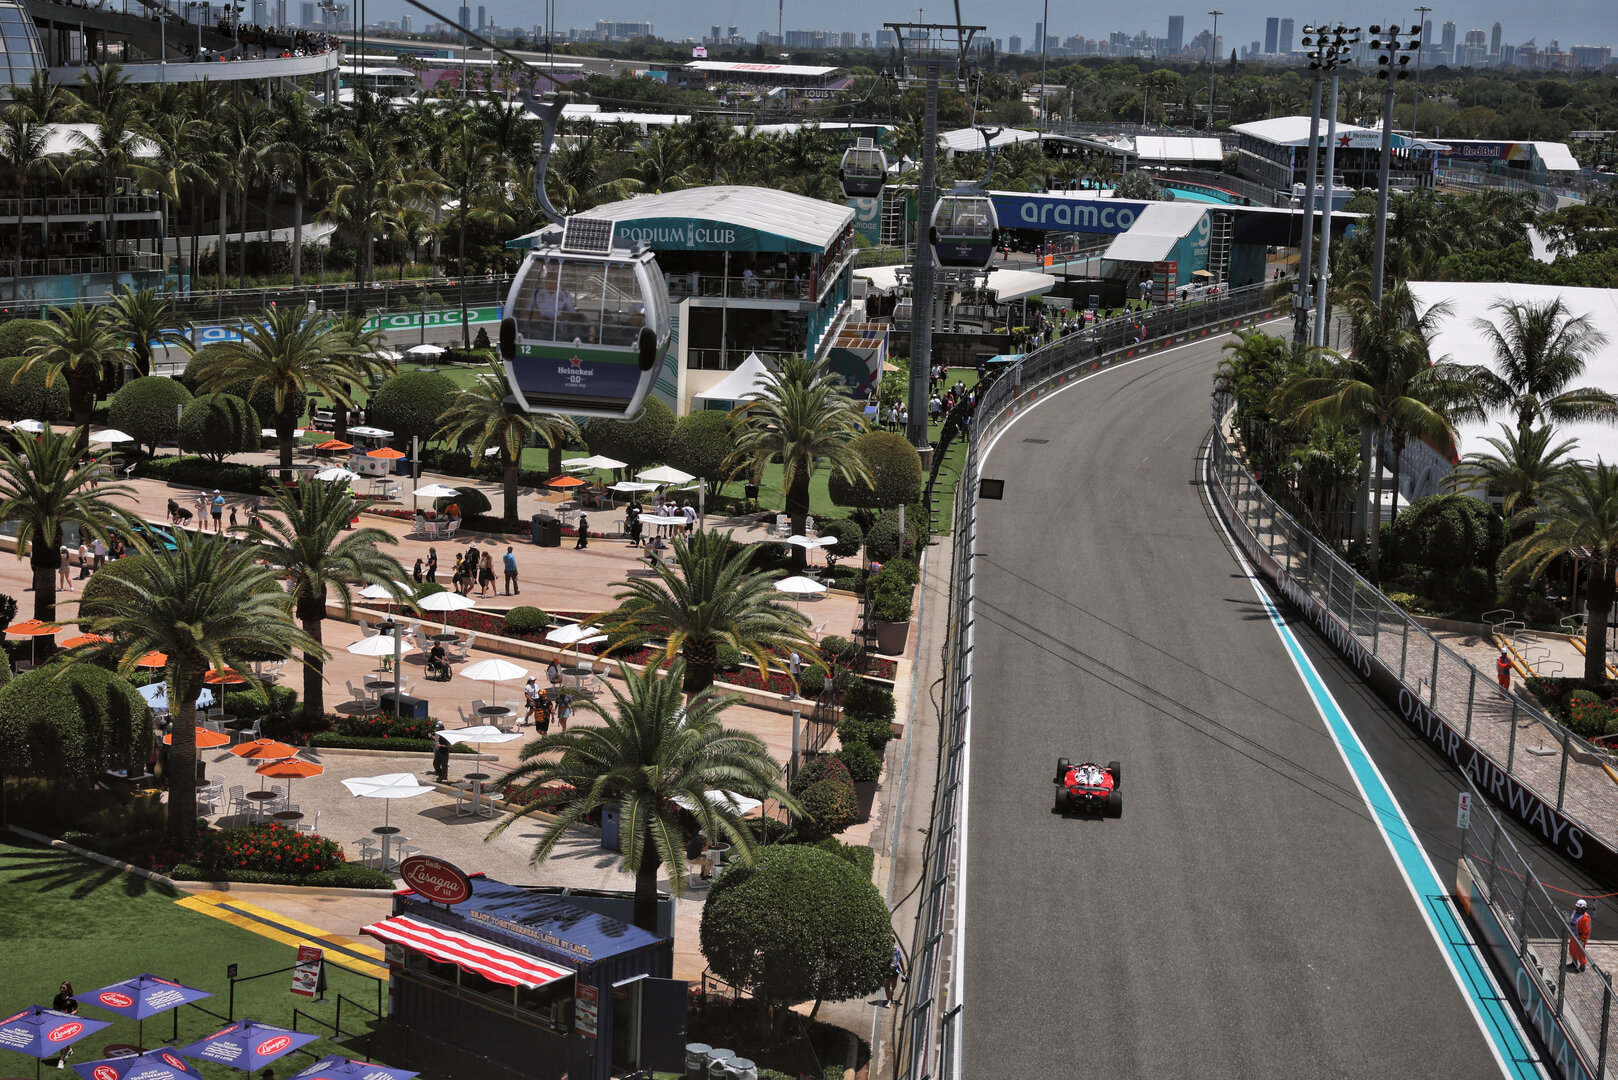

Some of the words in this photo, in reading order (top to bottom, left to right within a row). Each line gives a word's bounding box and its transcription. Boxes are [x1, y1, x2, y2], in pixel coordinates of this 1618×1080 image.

[804, 90, 829, 98] LOUIS
[1463, 146, 1482, 156] Red
[1482, 146, 1500, 157] Bull
[1020, 202, 1134, 230] aramco
[620, 227, 685, 242] PODIUM
[695, 228, 736, 244] CLUB
[1198, 212, 1211, 247] 9
[520, 345, 532, 355] 12
[557, 366, 594, 376] Heineken
[1276, 568, 1313, 621] QATAR
[1314, 613, 1372, 678] AIRWAYS
[1398, 687, 1461, 766] QATAR
[1465, 751, 1584, 860] AIRWAYS
[407, 864, 460, 892] Lasagna
